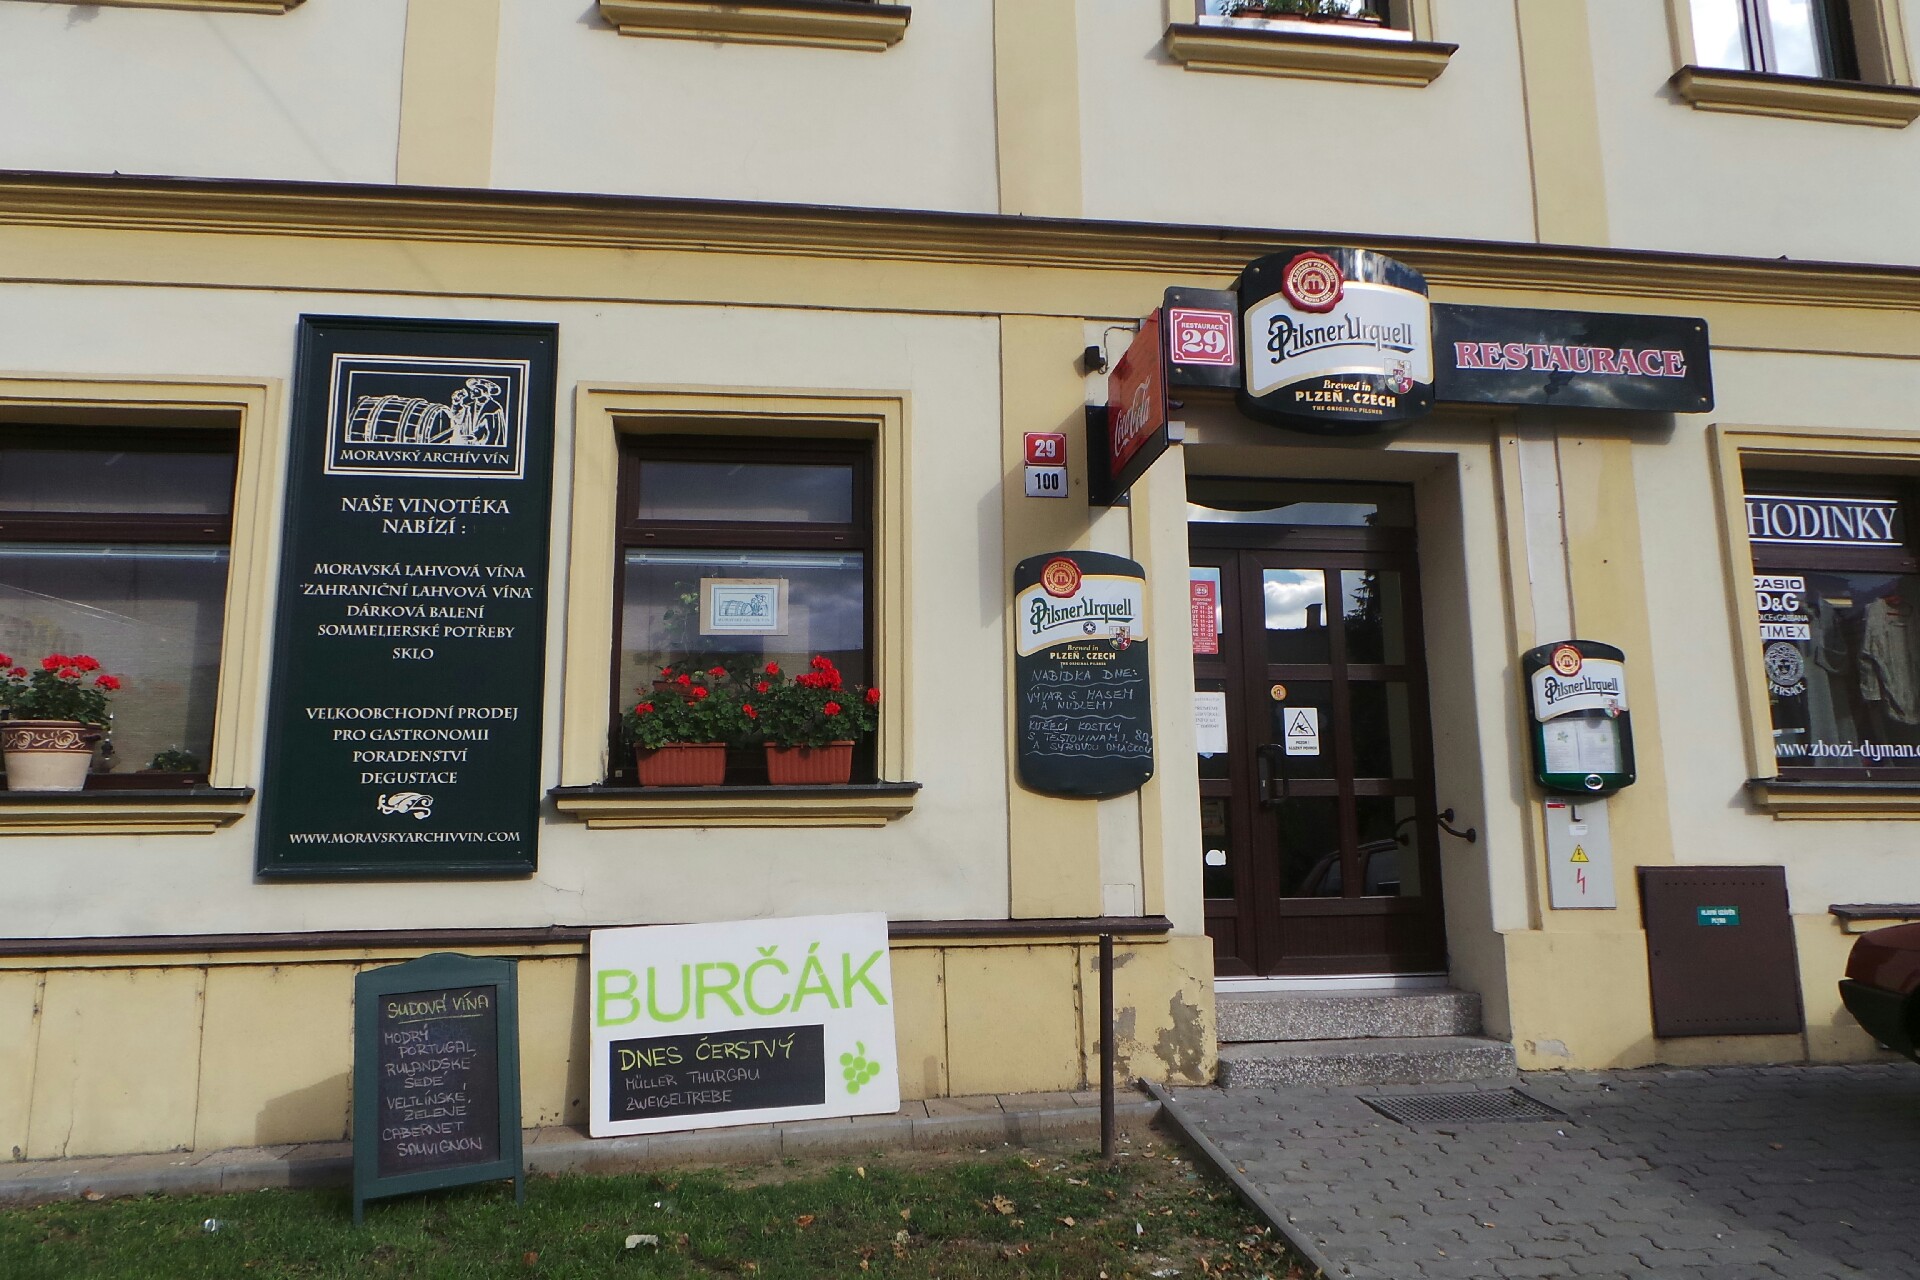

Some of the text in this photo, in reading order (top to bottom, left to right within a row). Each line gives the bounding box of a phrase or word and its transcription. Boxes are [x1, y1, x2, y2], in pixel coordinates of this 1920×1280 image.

[1181, 322, 1224, 331] RESTAURACE
[1181, 329, 1226, 354] 29
[1267, 313, 1412, 364] Pilsner Urquell
[1454, 341, 1687, 379] RESTAURACE
[1323, 379, 1371, 392] Brewed in
[1295, 389, 1343, 403] PLZEŇ
[1353, 392, 1396, 408] CZECH
[340, 449, 510, 464] MORAVSKÝ ARCHÍV VÍN
[1034, 439, 1056, 458] 29
[1035, 472, 1059, 491] 100
[341, 494, 511, 514] NAŠE VINOTÉKA
[382, 517, 456, 535] NABÍZÍ
[1745, 502, 1897, 540] HODINKY
[313, 562, 526, 578] MORAVSKÁ LAHVOVÁ VÍNA
[303, 582, 532, 599] ZAHRANIČNÍ LAHVOVÁ VÍNA
[1757, 592, 1799, 612] D&G
[346, 603, 485, 619] DÁRKOVÁ BALENÍ
[1030, 596, 1132, 635] Pilsner Urquell
[318, 623, 515, 639] SOMMELIERSKÉ POTŘEBY
[392, 648, 435, 660] SKLO
[1086, 652, 1116, 660] CZECH
[1068, 690, 1078, 700] S
[1544, 674, 1619, 705] Pilsner Urquell
[1768, 681, 1806, 697] VERSACE
[305, 705, 519, 721] VELKOOBCHODNÍ PRODEJ
[1040, 702, 1048, 710] A
[332, 728, 489, 742] PRO GASTRONOMII
[1078, 721, 1122, 732] KOSTKY
[1027, 731, 1036, 740] S
[1032, 740, 1040, 750] A
[353, 748, 468, 763] PORADENSTVÍ
[360, 772, 458, 785] DEGUSTACE
[289, 831, 521, 844] WWW.MORAVSKYARCHIVVIN.COM
[596, 941, 889, 1028] BURČÁK
[387, 990, 489, 1019] SUDOVÁ VÍNA
[384, 1023, 429, 1045] MODRÝ
[398, 1041, 476, 1058] PORTUGAL
[384, 1053, 477, 1077] RULANDSKÉ
[617, 1046, 684, 1071] DNES
[625, 1068, 761, 1091] MÜLLER THURGAU
[626, 1089, 733, 1111] ZWEIGELTREBE
[403, 1099, 471, 1121] ZELENÉ
[382, 1121, 464, 1141] CABERNET
